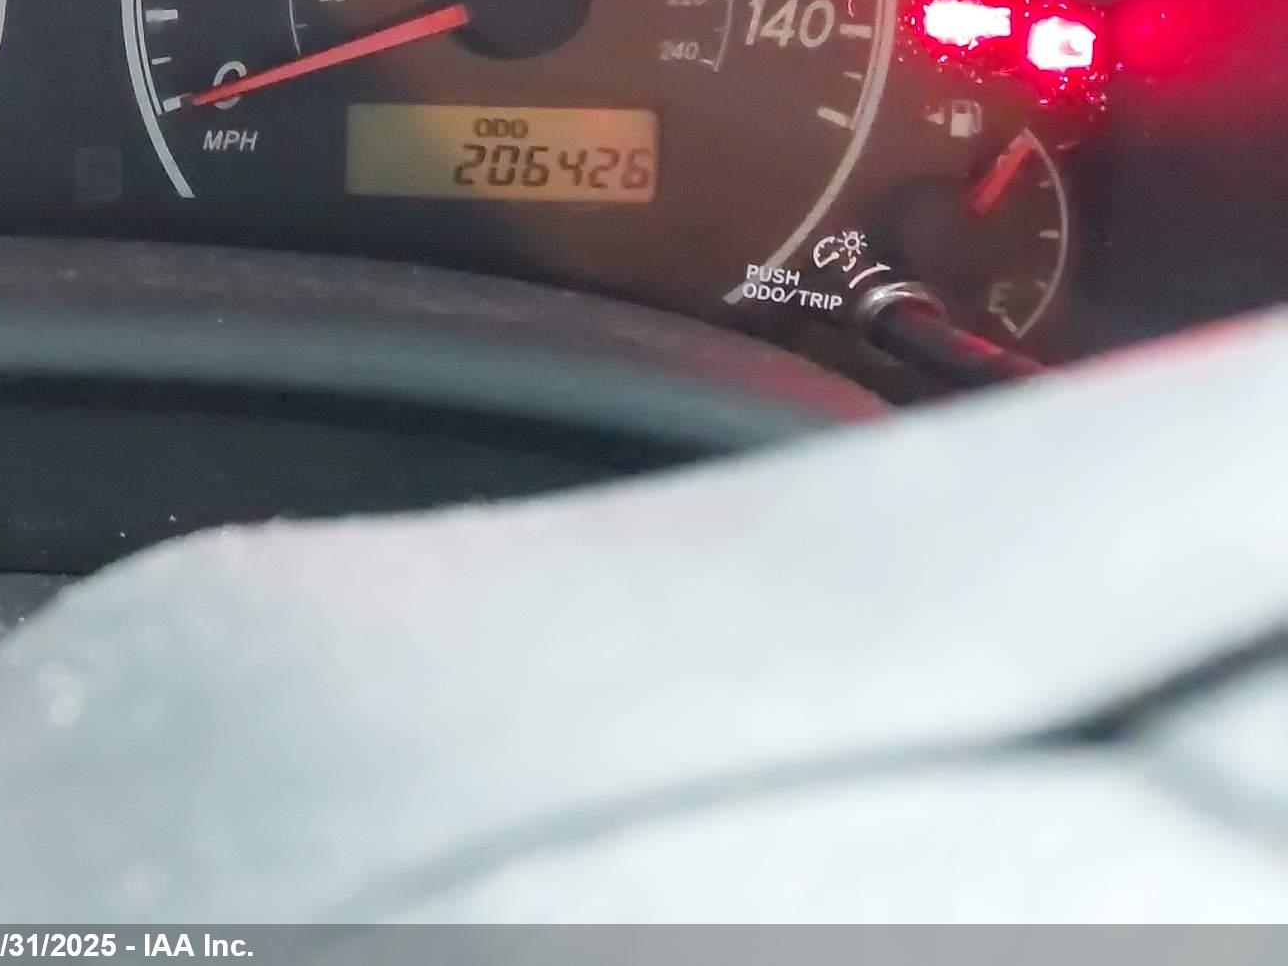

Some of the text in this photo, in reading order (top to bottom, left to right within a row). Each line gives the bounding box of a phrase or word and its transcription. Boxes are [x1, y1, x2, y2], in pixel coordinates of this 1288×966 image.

[660, 40, 699, 61] 240
[473, 117, 529, 139] ODO
[202, 129, 258, 151] MPH
[452, 144, 652, 190] 206426
[746, 265, 800, 285] PUSH
[742, 283, 843, 311] ODO/TRIP
